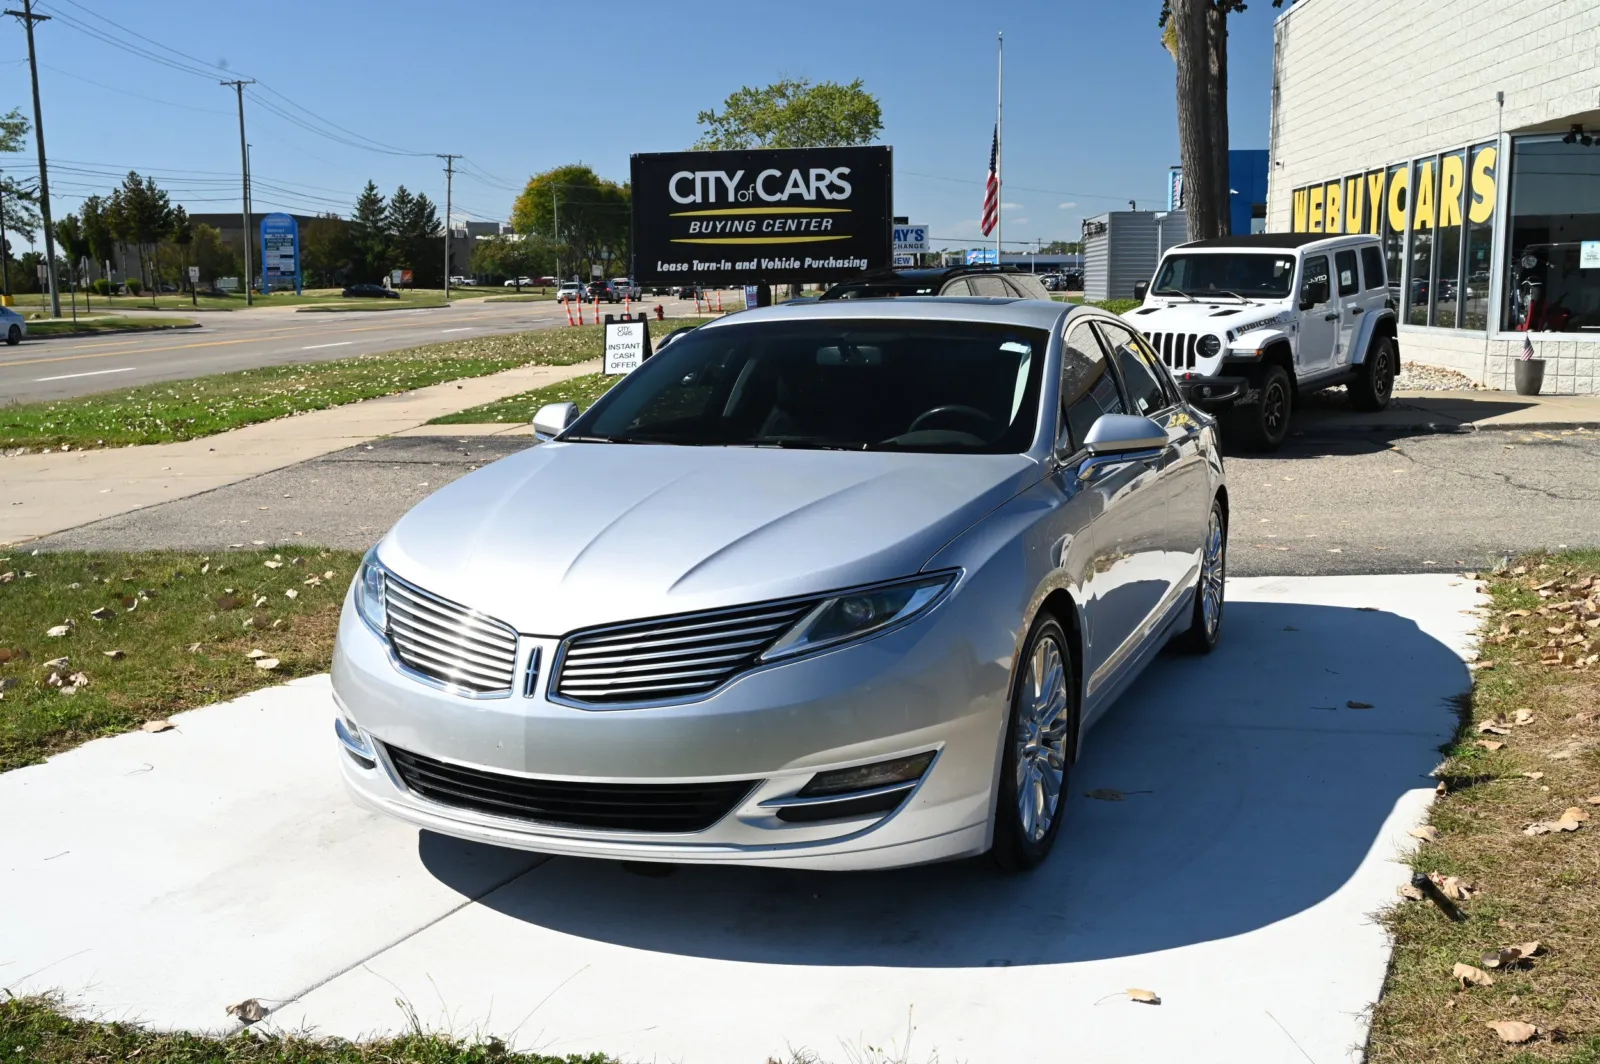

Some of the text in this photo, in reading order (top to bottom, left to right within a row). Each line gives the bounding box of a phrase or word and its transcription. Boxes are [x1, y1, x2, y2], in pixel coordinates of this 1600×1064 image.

[668, 166, 852, 204] CITY of CARS
[689, 218, 833, 234] BUYING CENTER
[893, 229, 924, 242] AY'S
[656, 256, 868, 272] Lease Turn-In and Vehicle Purchasing
[1236, 316, 1276, 333] RUBICON
